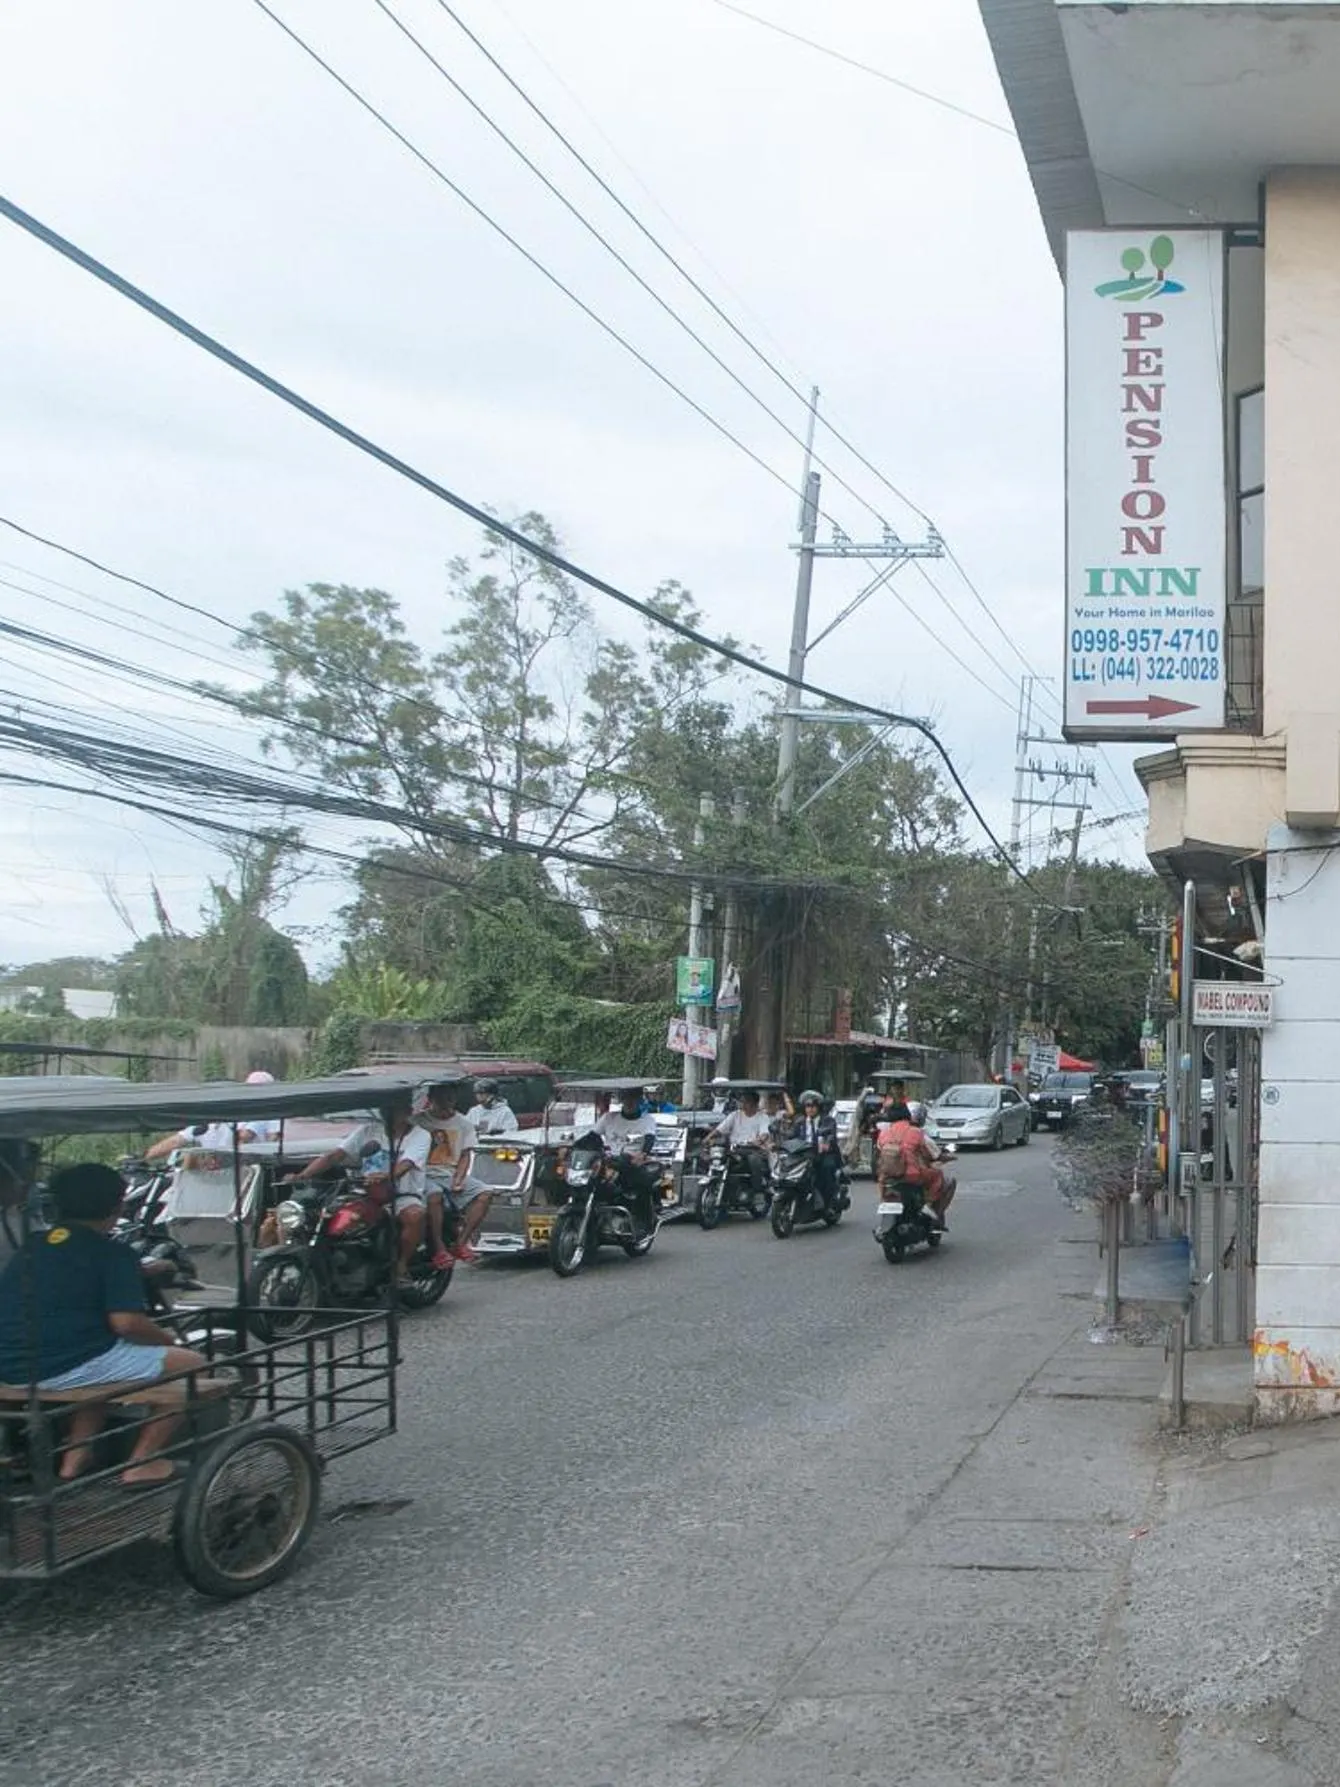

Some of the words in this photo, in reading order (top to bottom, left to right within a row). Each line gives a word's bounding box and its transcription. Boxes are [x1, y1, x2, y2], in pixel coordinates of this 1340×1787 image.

[1120, 311, 1167, 556] PENSION
[1084, 567, 1201, 597] INN
[1074, 606, 1105, 618] Your
[1108, 606, 1146, 618] Home
[1149, 606, 1162, 618] in
[1165, 605, 1215, 618] Marilao
[1071, 628, 1219, 653] 0998-957-4710
[1072, 657, 1096, 681] LL:
[1101, 656, 1141, 686] (044)
[1146, 656, 1219, 681] 322-0028
[1225, 991, 1270, 1013] COMPOUND
